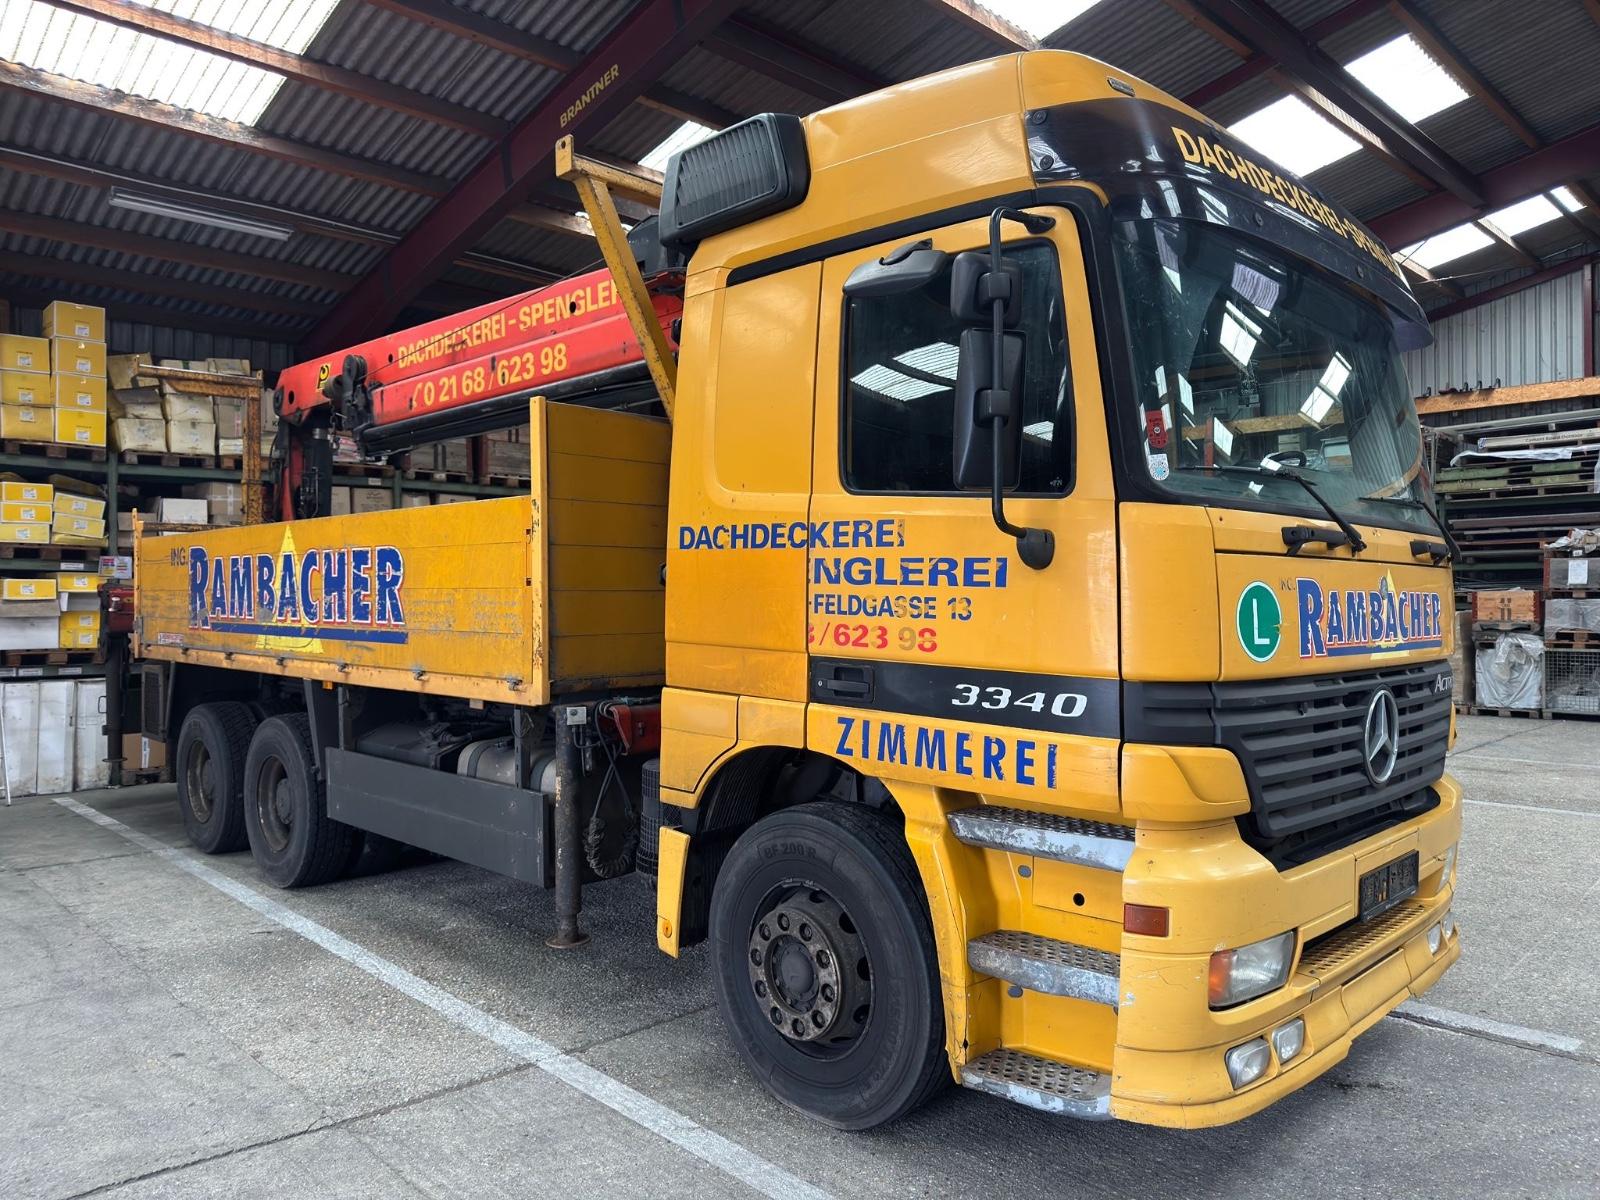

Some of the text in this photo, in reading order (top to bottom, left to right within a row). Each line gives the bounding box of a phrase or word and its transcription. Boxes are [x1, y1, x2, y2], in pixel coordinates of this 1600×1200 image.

[560, 64, 619, 128] BRANTNER
[541, 342, 568, 375] 98
[679, 519, 905, 550] DACHDECKEREI
[188, 546, 407, 632] RAMBACHER
[808, 557, 1008, 588] NGLEREI
[947, 597, 973, 621] 13
[1252, 598, 1270, 645] L
[1296, 577, 1441, 658] RAMBACHER
[898, 627, 938, 653] 98
[951, 683, 1088, 717] 3340
[836, 716, 1058, 789] ZIMMEREI
